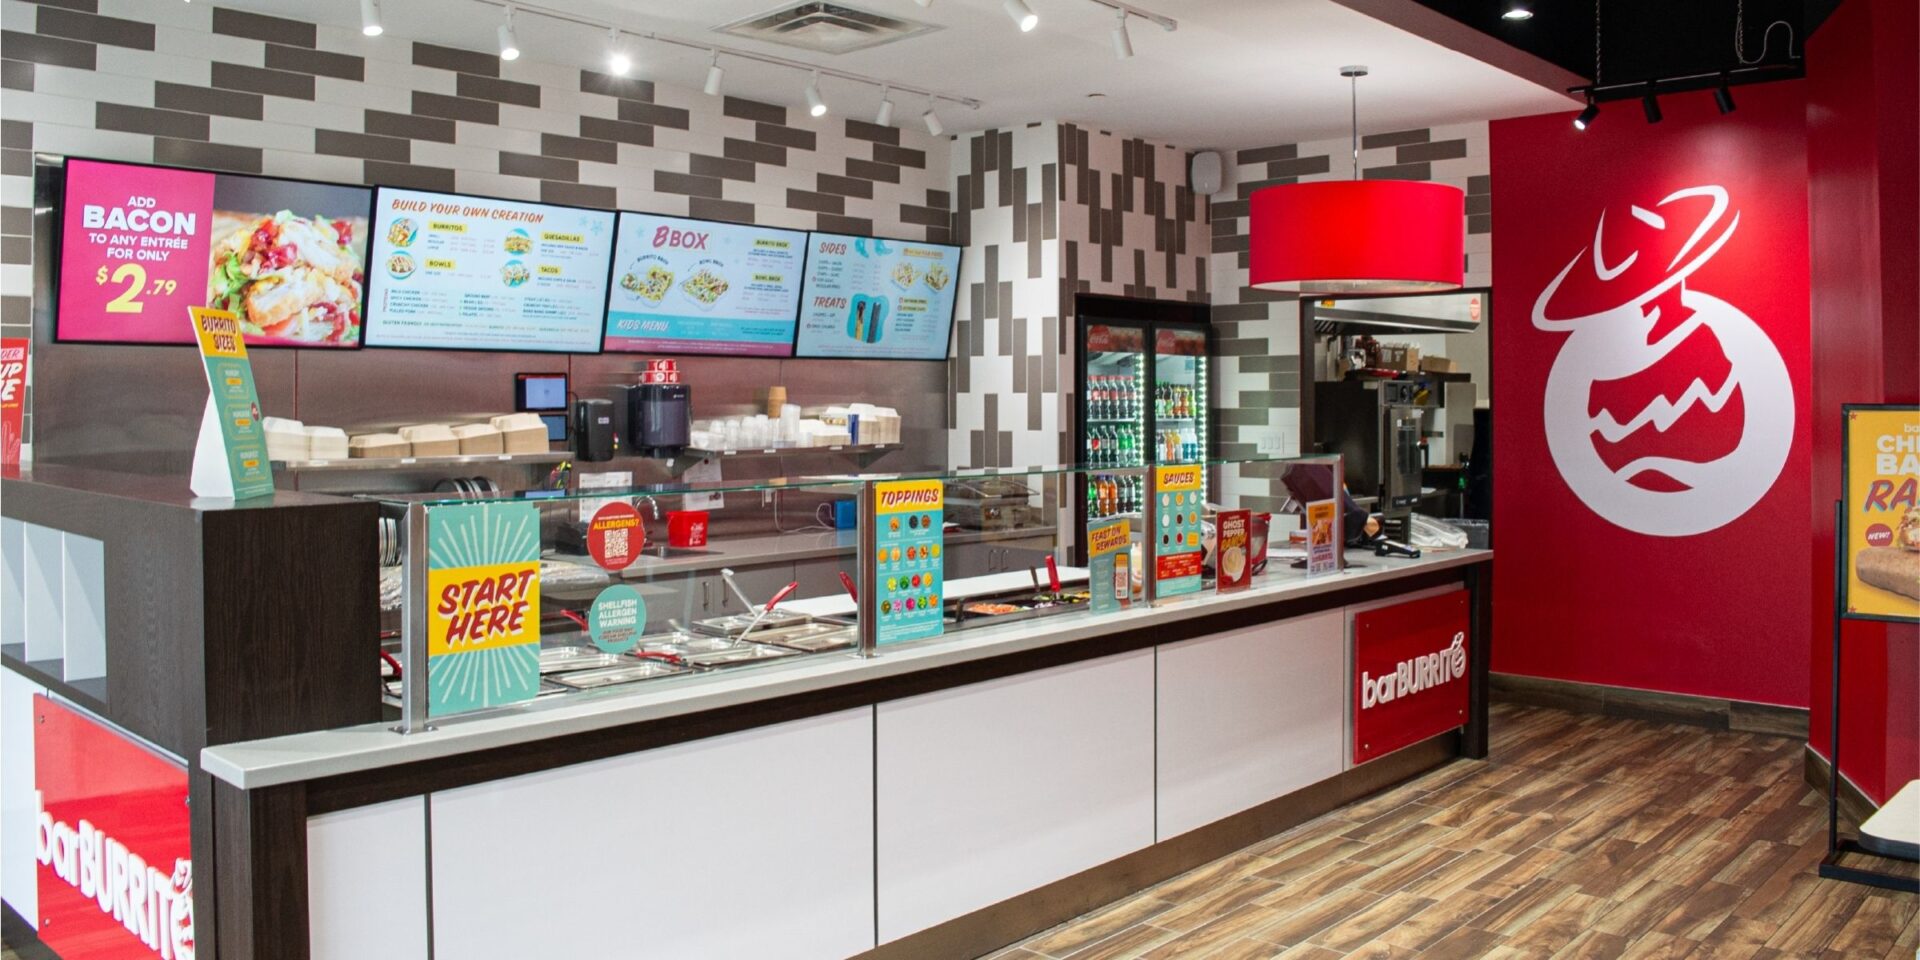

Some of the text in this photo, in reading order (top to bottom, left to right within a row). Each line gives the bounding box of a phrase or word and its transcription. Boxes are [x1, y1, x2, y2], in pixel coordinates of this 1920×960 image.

[127, 196, 156, 208] ADD
[391, 199, 544, 223] BUILD YOUR OWN CREATION
[83, 204, 196, 235] BACON
[433, 223, 463, 231] BURRITOS
[89, 233, 188, 249] TO ANY ENTRÉE
[544, 233, 580, 242] QUESADILLAS
[107, 247, 170, 261] FOR ONLY
[819, 242, 847, 255] SIDES
[429, 261, 452, 269] BOWLS
[541, 266, 558, 274] TACOS
[814, 296, 847, 309] TREATS
[201, 314, 236, 334] BURRITO
[213, 333, 237, 352] SIZES
[1163, 472, 1195, 485] SAUCES
[881, 488, 939, 507] TOPPINGS
[593, 518, 640, 530] ALLERGENS?
[1223, 519, 1246, 530] GHOST
[1092, 525, 1121, 541] FEAST ON
[1096, 534, 1127, 551] REWARDS
[437, 569, 535, 617] START
[598, 599, 638, 611] SHELLFISH
[599, 607, 637, 620] ALLERGEN
[446, 600, 529, 647] HERE
[599, 616, 637, 628] WARNING
